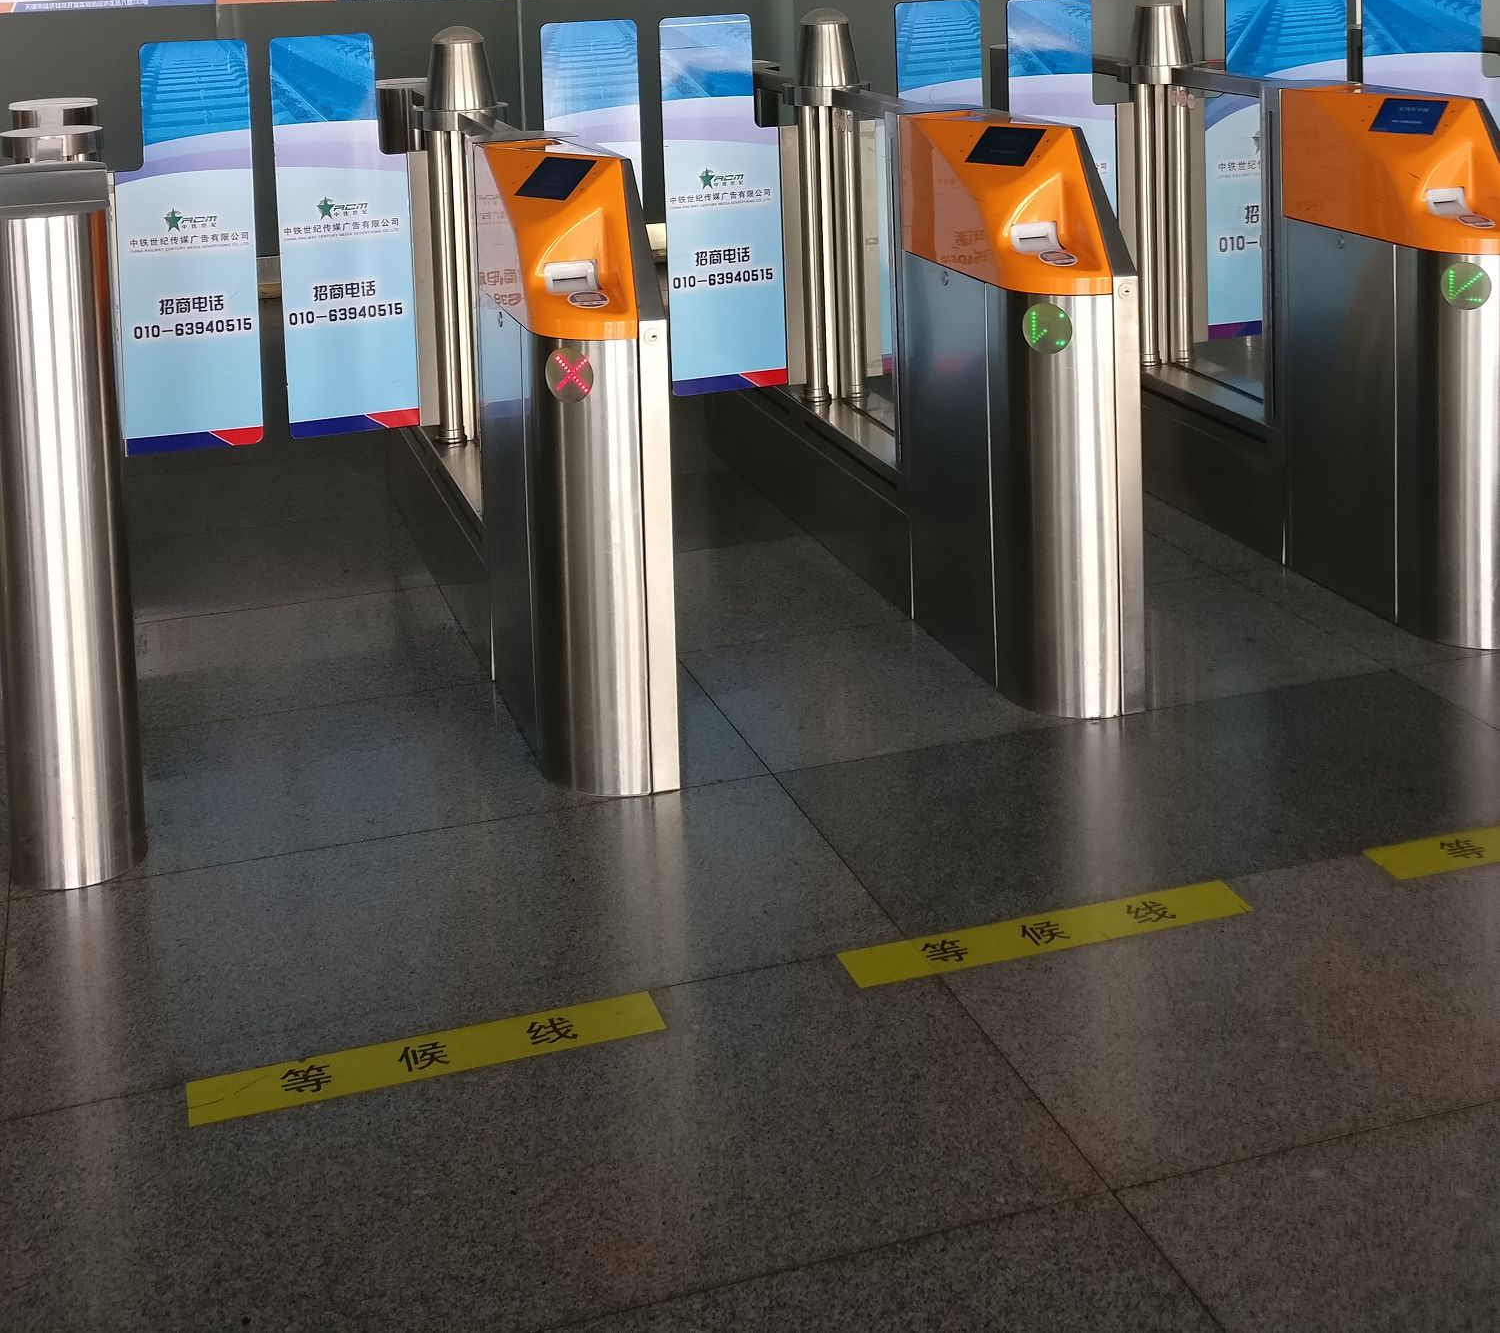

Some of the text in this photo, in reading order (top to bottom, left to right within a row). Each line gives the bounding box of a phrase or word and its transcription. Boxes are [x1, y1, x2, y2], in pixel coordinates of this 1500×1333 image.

[670, 188, 771, 204] 中铁世纪传媒广告有限公司
[284, 218, 399, 236] 中铁世纪传媒广告有限公司
[130, 232, 249, 248] 中铁世纪传媒广告有限公司
[1219, 235, 1261, 253] 010-
[695, 247, 750, 266] 招商电话
[673, 268, 773, 289] 010-63940515
[313, 281, 376, 301] 招商电话
[159, 295, 224, 315] 招商电话
[289, 303, 403, 325] 010-63940515
[134, 318, 251, 340] 010-63940515
[1440, 838, 1486, 859] 等
[920, 900, 1177, 962] 等候线
[280, 1016, 578, 1094] 等候线
